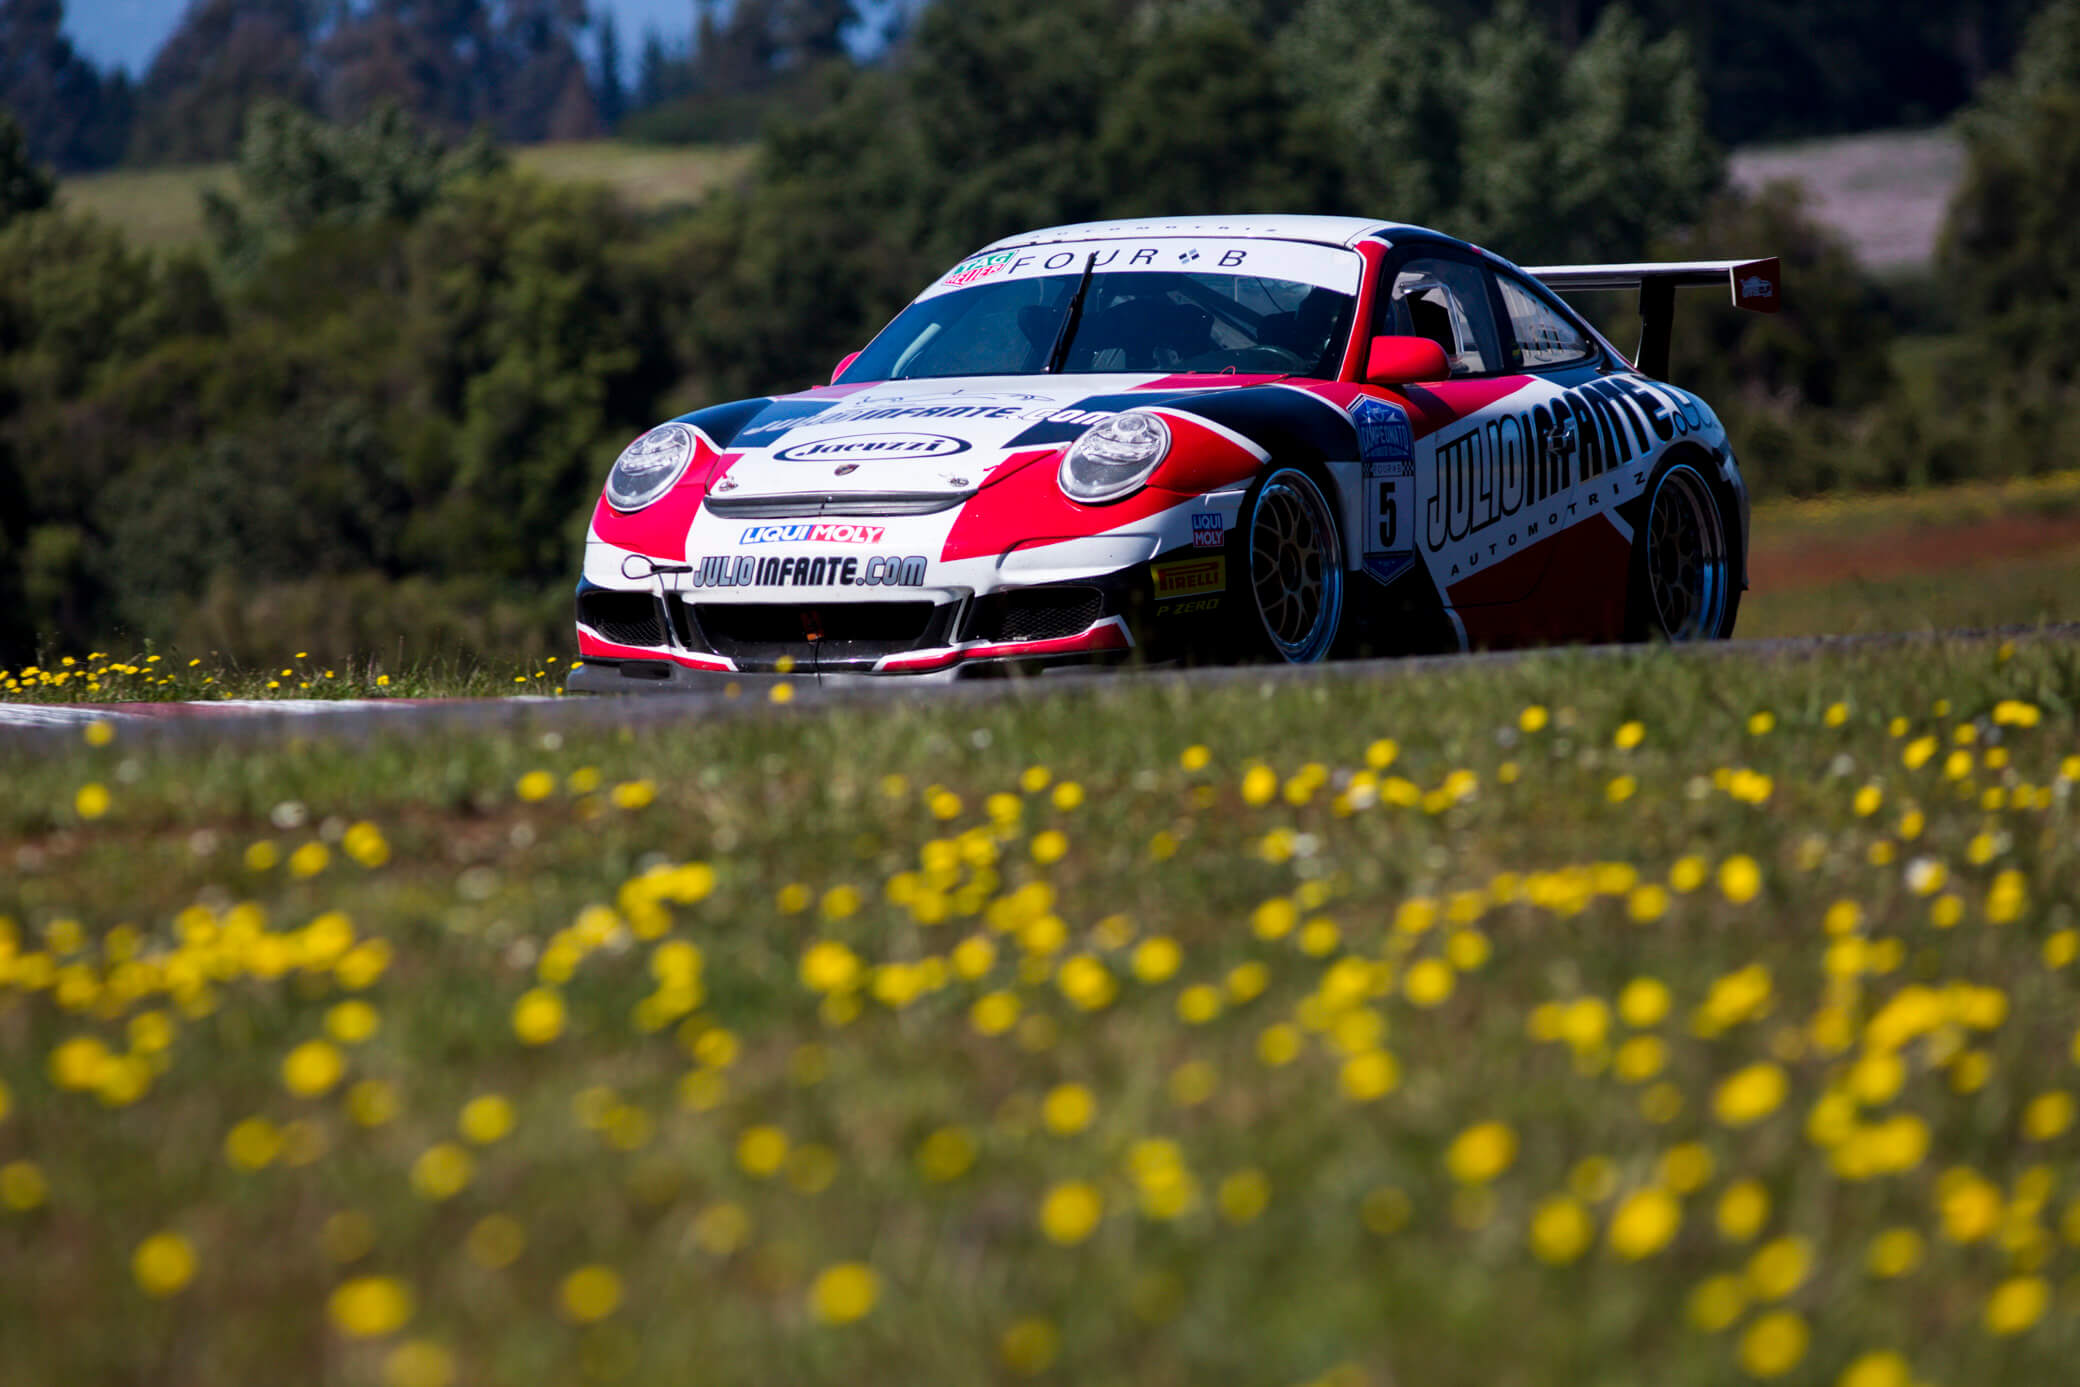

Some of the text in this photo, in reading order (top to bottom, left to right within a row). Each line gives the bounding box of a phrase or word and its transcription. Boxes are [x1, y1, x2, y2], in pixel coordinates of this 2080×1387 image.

[1007, 248, 1248, 274] FOUR B
[794, 439, 946, 457] Jacuzzi
[1193, 514, 1223, 529] LIQUI
[1379, 481, 1397, 548] 5
[1450, 472, 1646, 577] AUTOMOTRIZ
[743, 525, 885, 544] LIQUI MOLY
[1194, 530, 1224, 545] MOLY
[1158, 561, 1219, 591] PIRELLI
[1156, 599, 1219, 617] P ZERO
